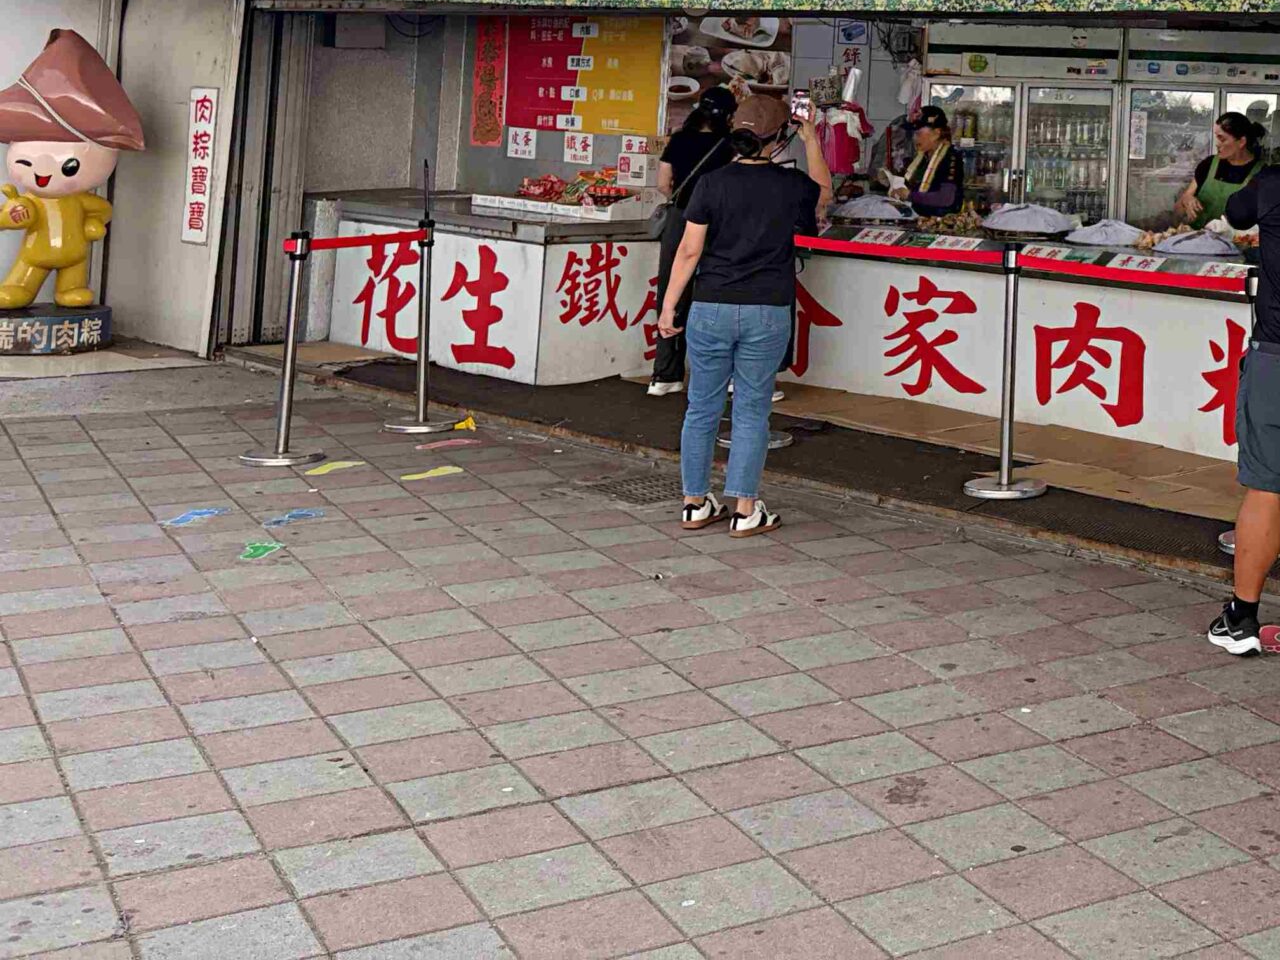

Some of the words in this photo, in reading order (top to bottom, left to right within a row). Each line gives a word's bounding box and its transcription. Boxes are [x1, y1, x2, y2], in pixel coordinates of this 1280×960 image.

[187, 95, 214, 232] 肉粽寶寶
[351, 232, 516, 370] 花生
